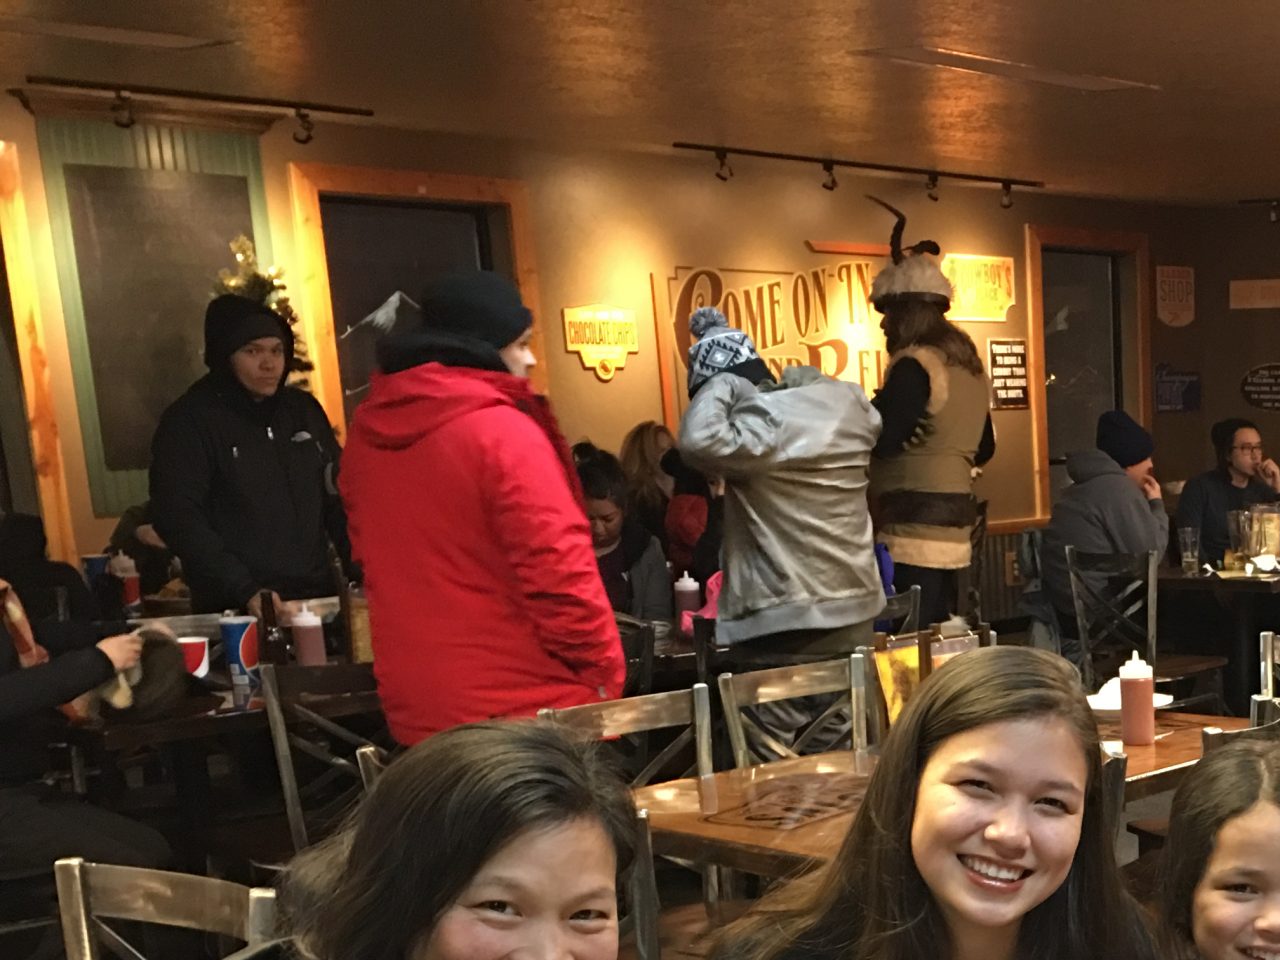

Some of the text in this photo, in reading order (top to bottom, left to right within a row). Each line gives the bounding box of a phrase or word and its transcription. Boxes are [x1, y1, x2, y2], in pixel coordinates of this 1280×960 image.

[1160, 280, 1192, 303] SHOP
[674, 269, 785, 371] COME
[568, 321, 635, 345] CHOCOLATE CHIPS
